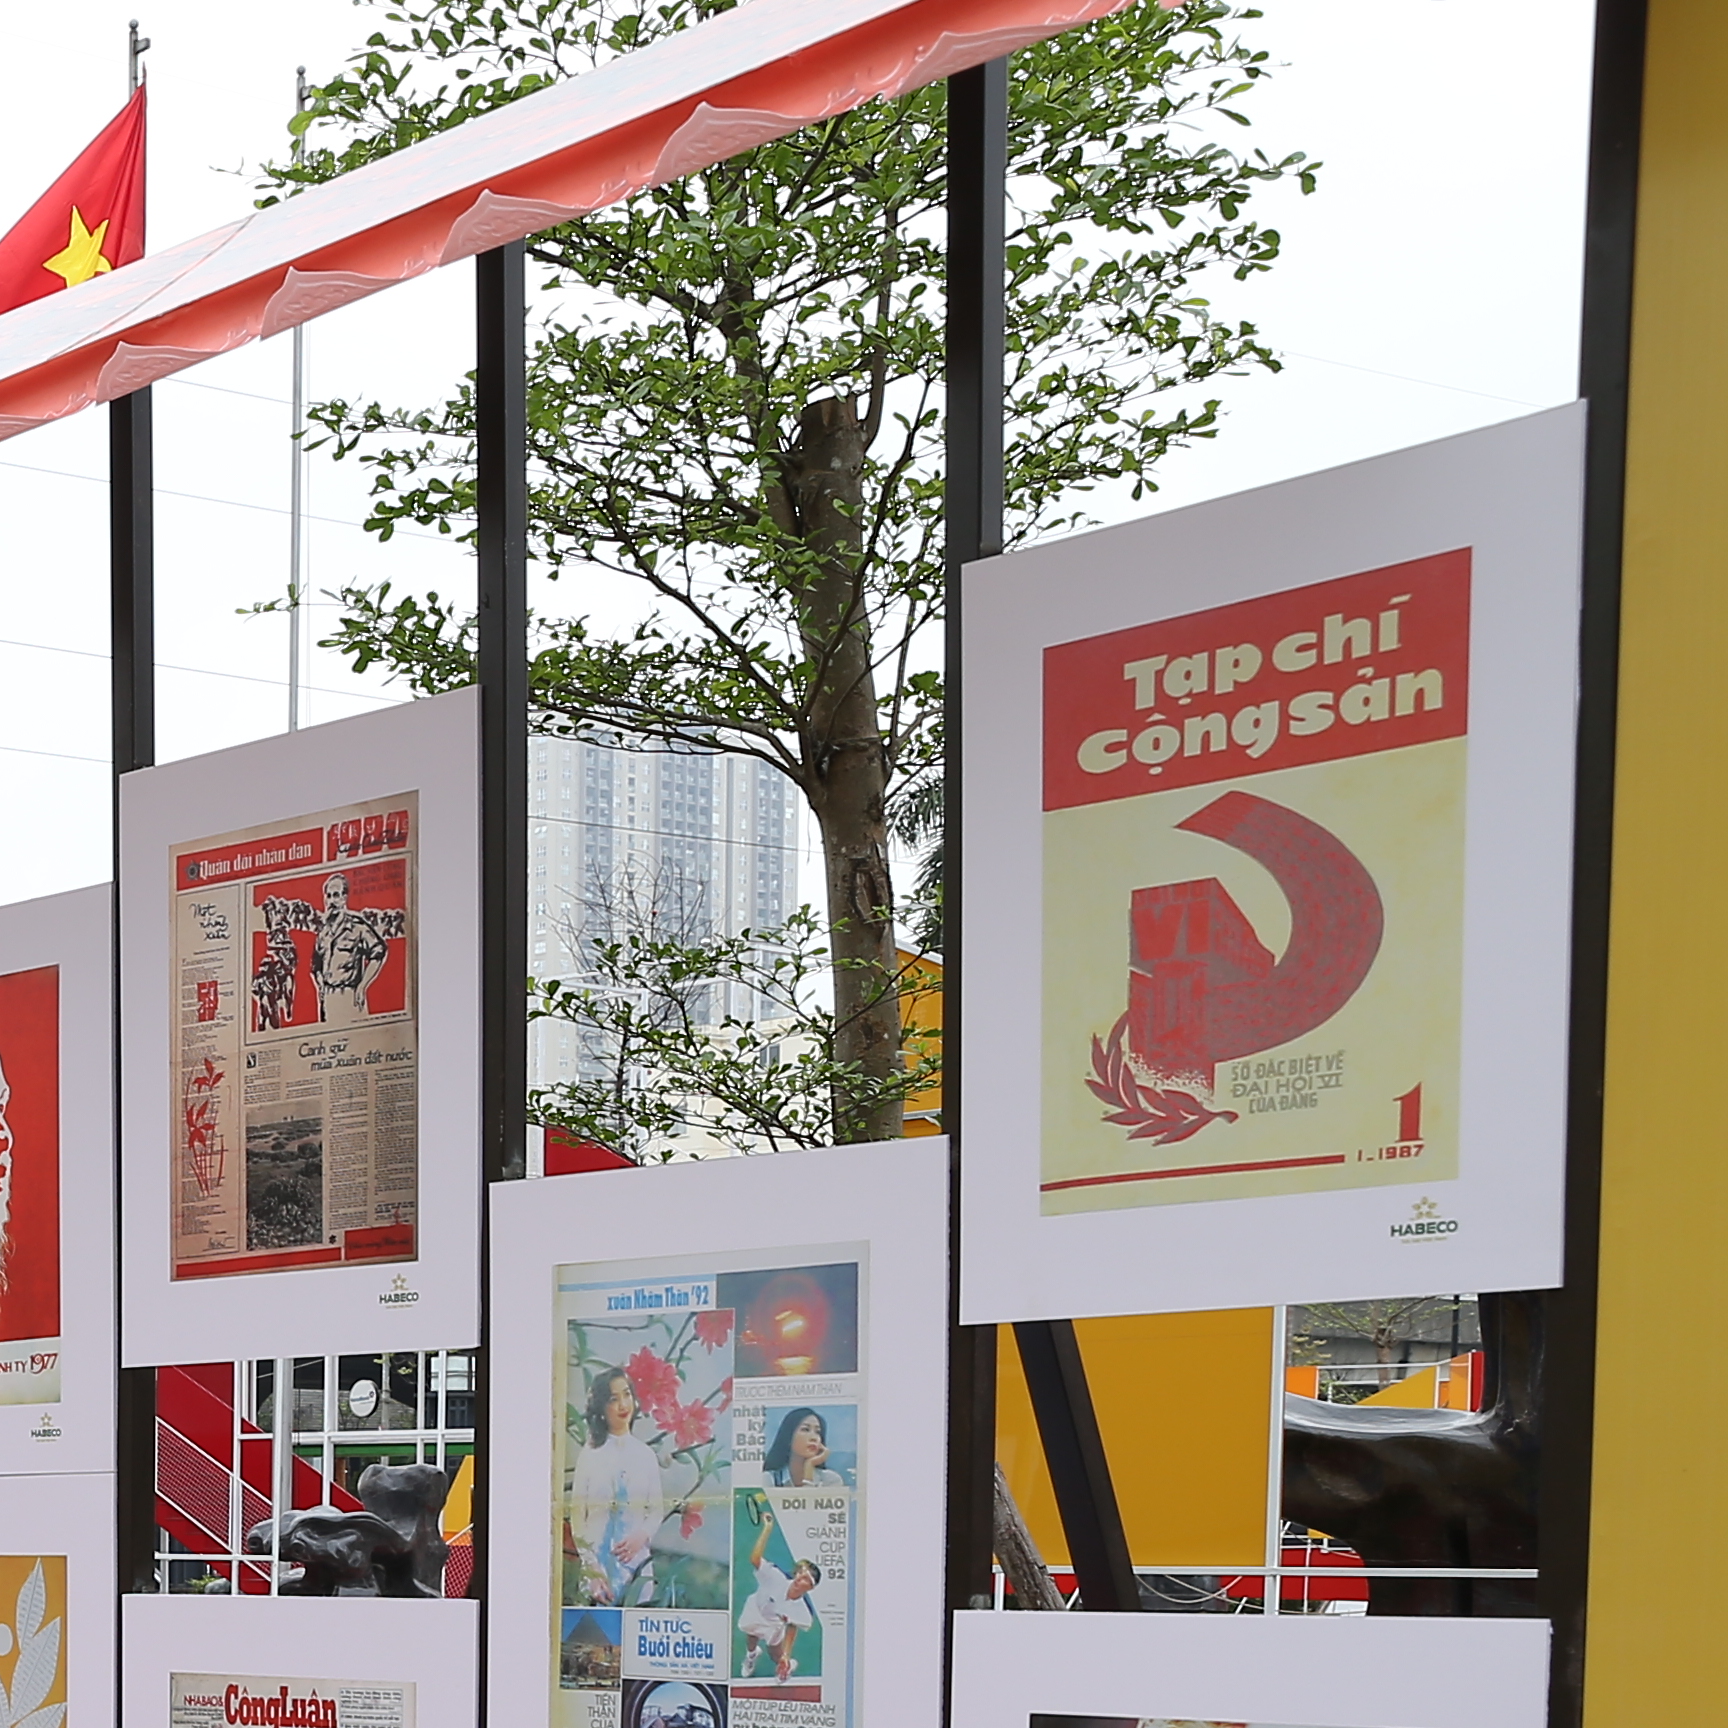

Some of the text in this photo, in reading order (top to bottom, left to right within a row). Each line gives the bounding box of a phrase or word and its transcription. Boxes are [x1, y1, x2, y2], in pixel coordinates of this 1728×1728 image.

[1122, 594, 1413, 711] Tạp chí
[1076, 667, 1444, 776] cộng sản
[1288, 1054, 1323, 1078] BIỆT
[1316, 1072, 1344, 1090] VI
[1392, 1081, 1424, 1144] 1
[1390, 1219, 1459, 1238] HABECO
[378, 1292, 419, 1305] HABECO
[29, 1353, 59, 1375] 1977
[30, 1429, 62, 1438] HABECO
[815, 1554, 846, 1567] UEFA
[827, 1568, 846, 1580] 92
